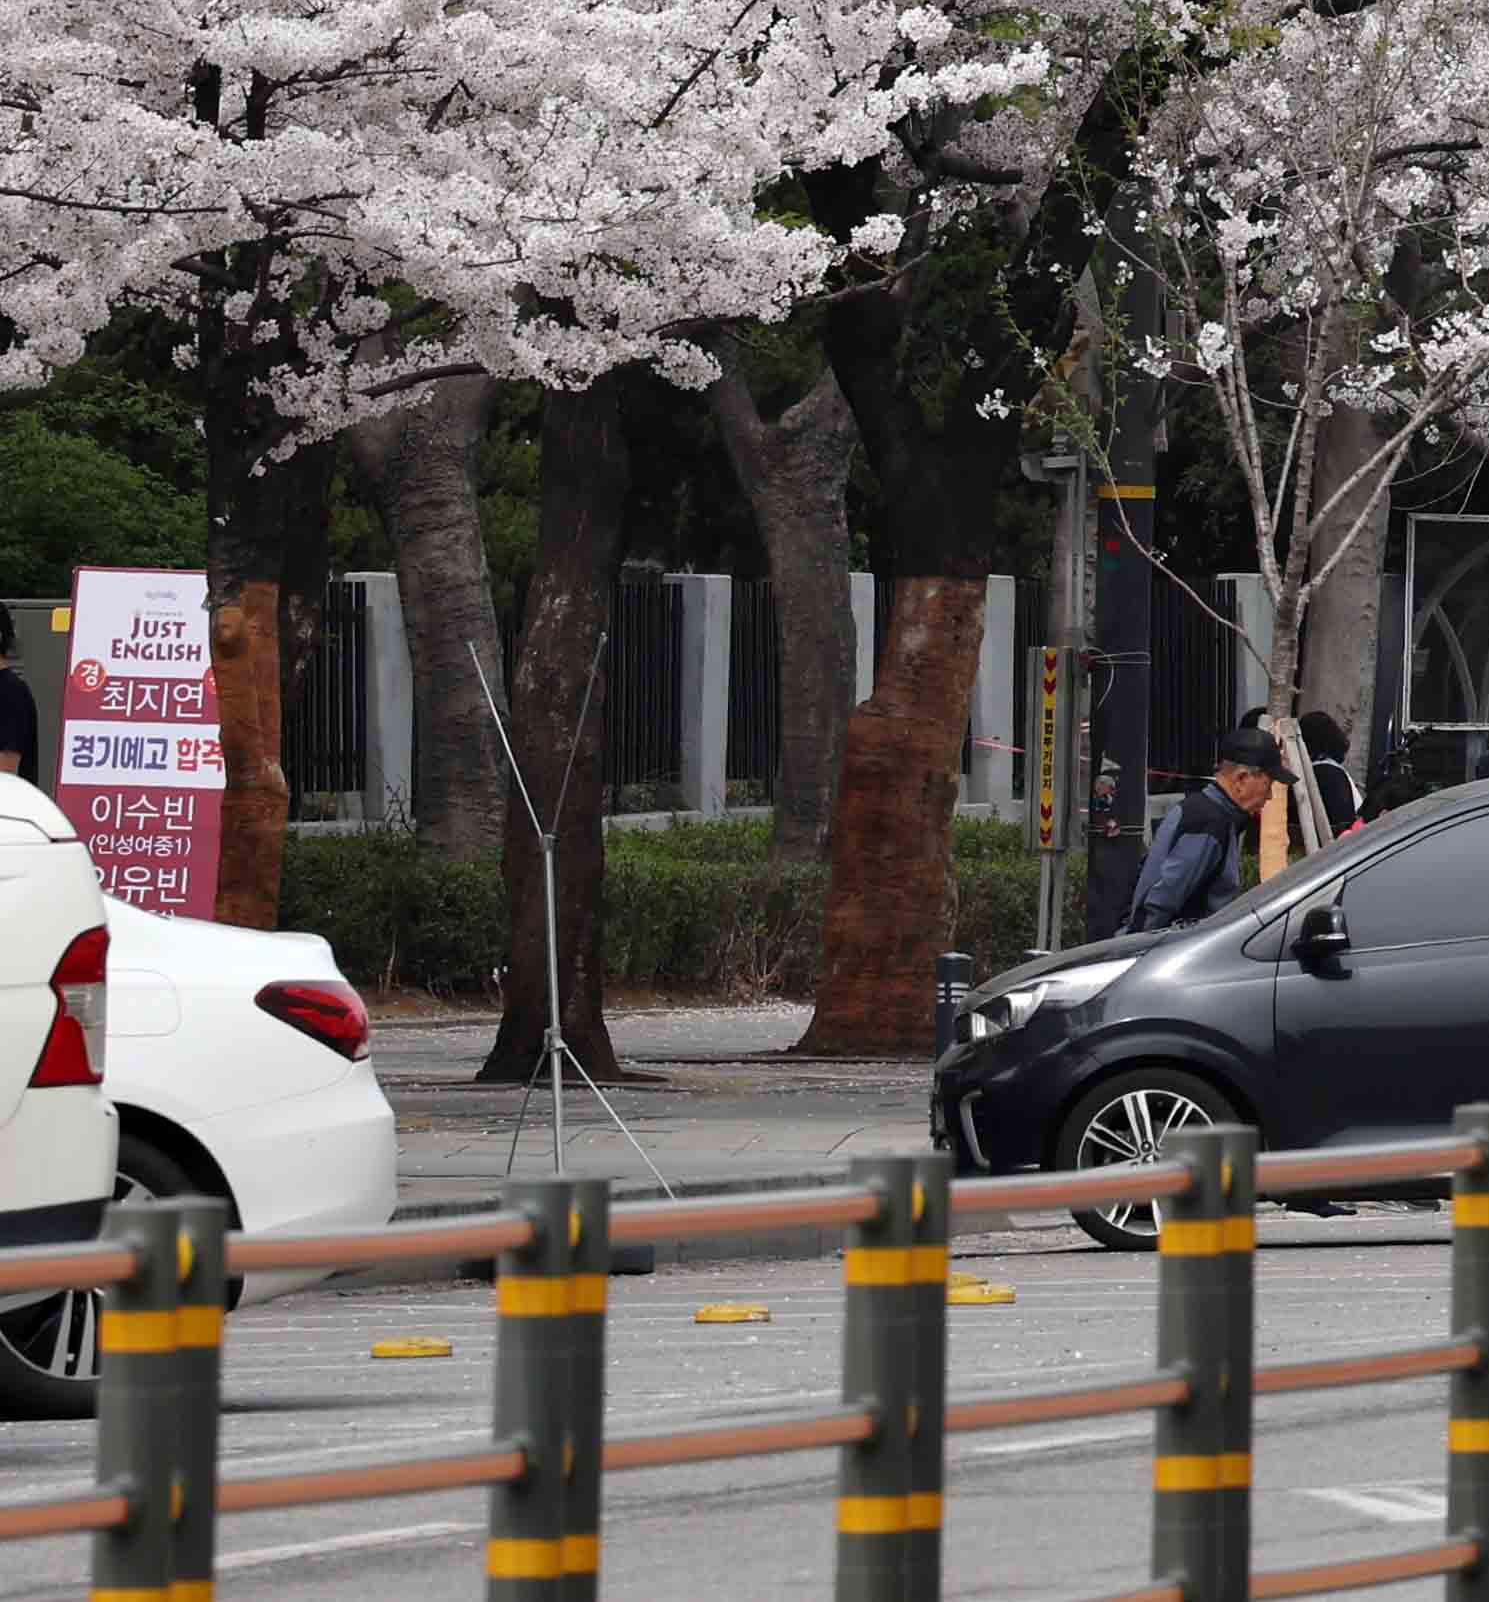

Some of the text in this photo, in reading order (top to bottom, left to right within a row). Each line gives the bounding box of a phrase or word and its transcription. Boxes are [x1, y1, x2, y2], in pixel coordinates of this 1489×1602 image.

[130, 617, 187, 641] JUST
[111, 638, 202, 662] ENGLISH
[81, 663, 99, 687] 경
[99, 680, 204, 719] 최지연
[71, 734, 224, 773] 경기예고 합격
[91, 793, 195, 831] 이수빈
[88, 834, 192, 857] (인성여중1)
